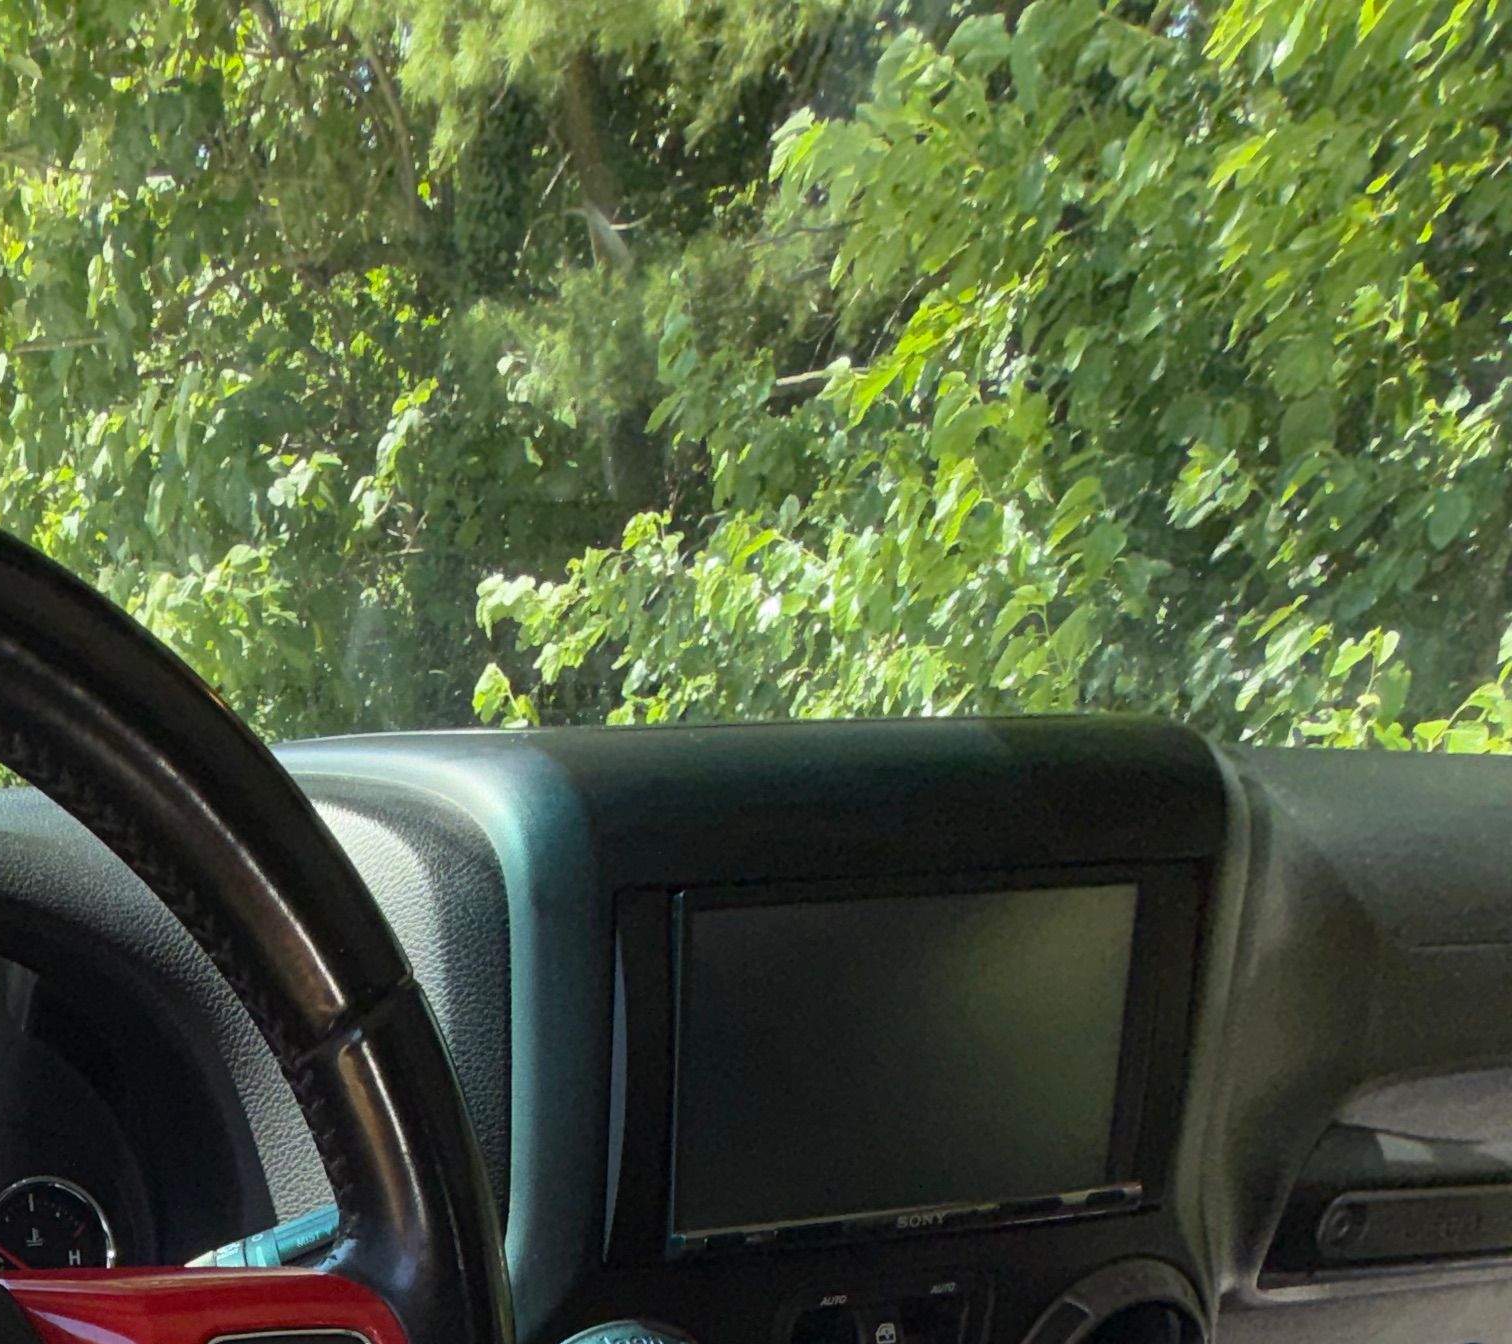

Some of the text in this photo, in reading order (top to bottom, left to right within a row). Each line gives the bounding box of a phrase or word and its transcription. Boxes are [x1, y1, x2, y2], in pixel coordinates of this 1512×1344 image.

[896, 1212, 946, 1230] SONY
[296, 1231, 320, 1248] MIST
[68, 1249, 81, 1266] H
[930, 1281, 956, 1296] AUTO
[820, 1293, 847, 1307] AUTO
